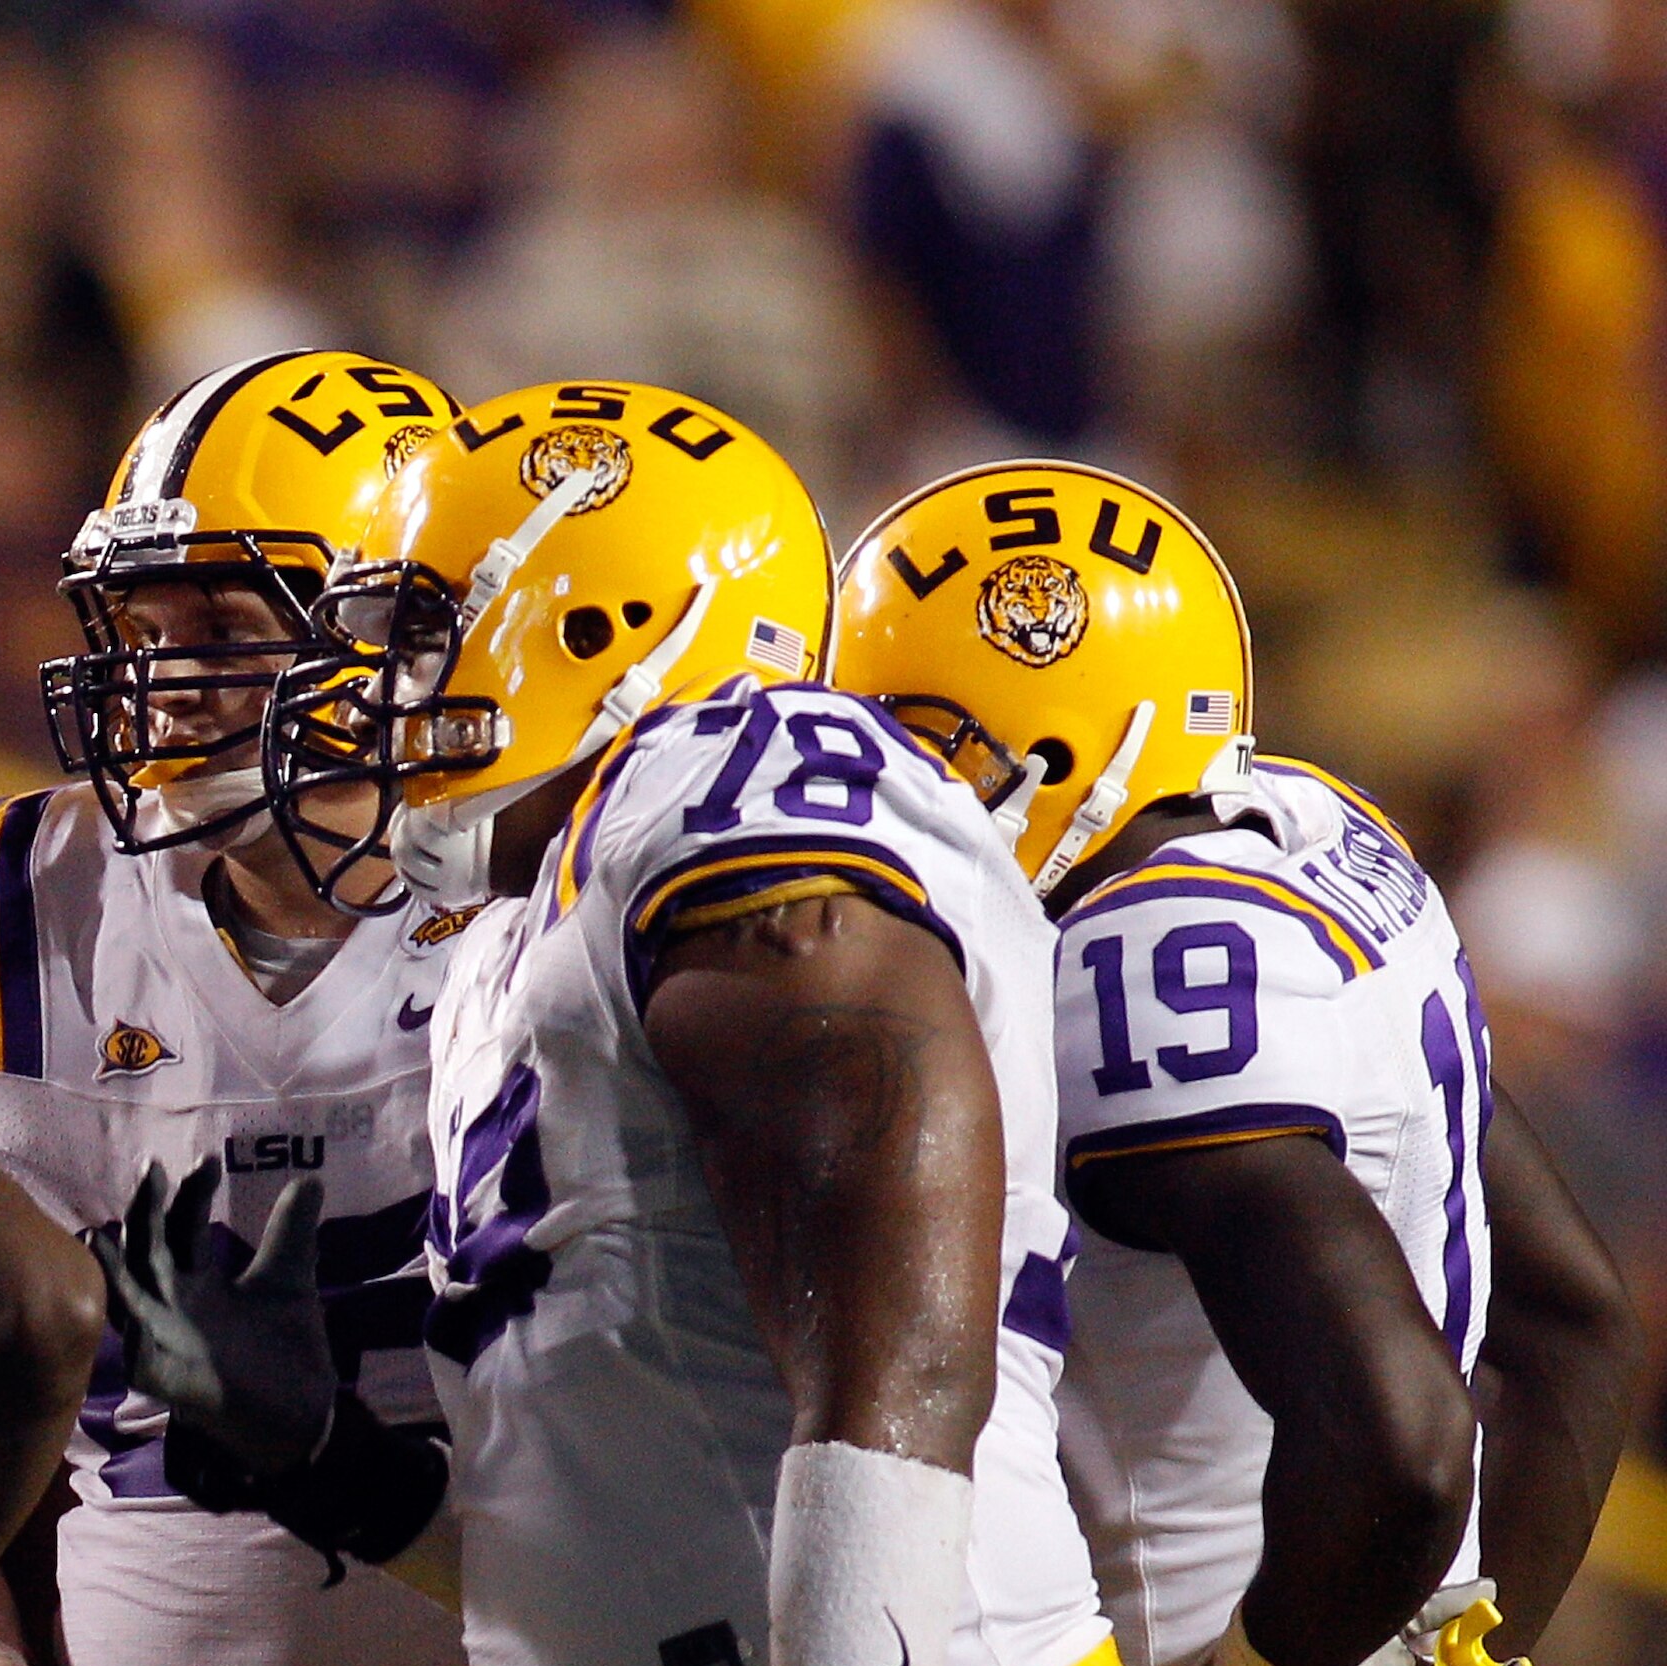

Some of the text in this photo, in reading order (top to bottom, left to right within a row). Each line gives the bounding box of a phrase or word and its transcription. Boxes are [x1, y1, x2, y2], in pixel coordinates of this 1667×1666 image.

[453, 384, 735, 462] LSU
[888, 488, 1162, 601] LSU
[682, 690, 884, 834] 78
[1082, 922, 1257, 1097] 19
[224, 1134, 325, 1173] LSU
